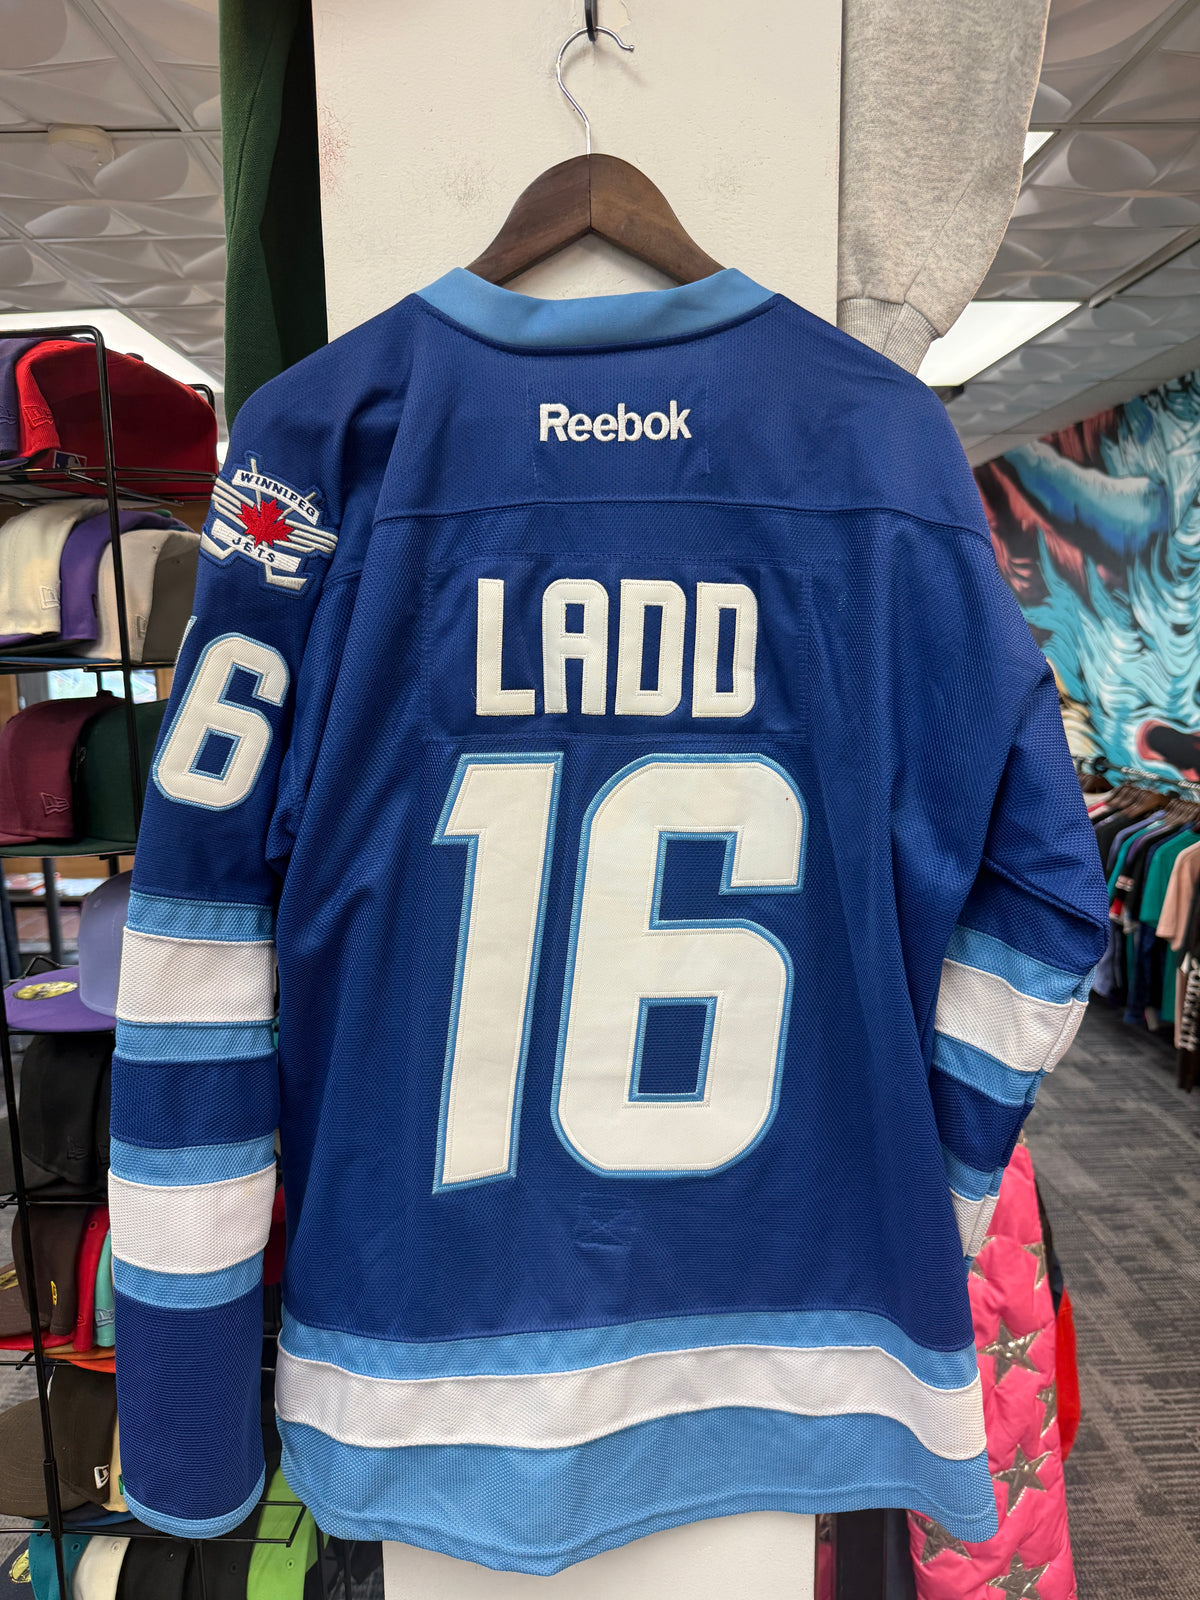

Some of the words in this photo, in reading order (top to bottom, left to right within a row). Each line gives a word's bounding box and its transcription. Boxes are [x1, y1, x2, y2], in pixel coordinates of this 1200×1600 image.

[539, 400, 692, 442] Reebok
[240, 472, 316, 518] WINNIPEG
[232, 537, 276, 563] JETS
[476, 578, 758, 718] LADD
[152, 616, 290, 811] 6
[432, 752, 808, 1195] 16
